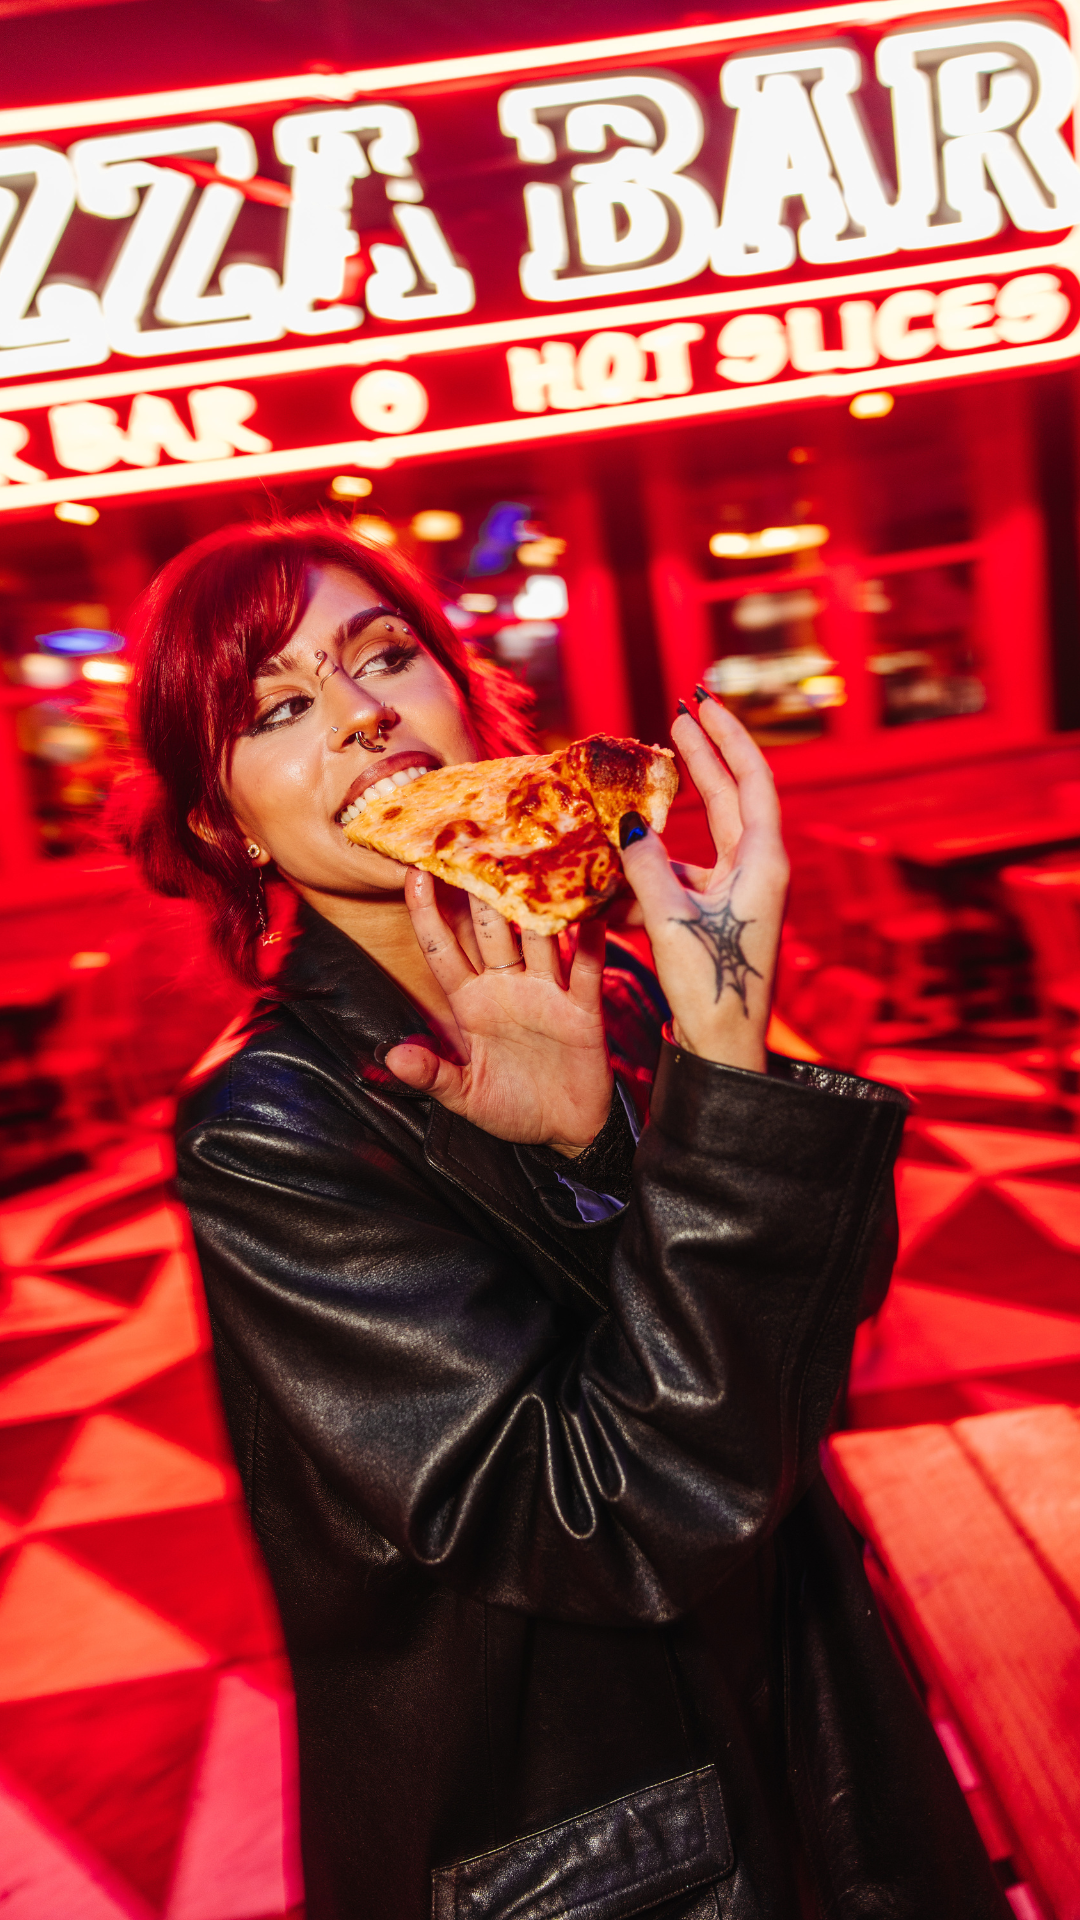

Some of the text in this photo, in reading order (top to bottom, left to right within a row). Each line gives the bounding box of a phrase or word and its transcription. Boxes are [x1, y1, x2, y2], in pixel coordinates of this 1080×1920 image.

[498, 19, 1080, 302] BAR
[48, 385, 273, 473] BAR
[505, 322, 706, 413] HOT
[715, 272, 1071, 383] SLICES
